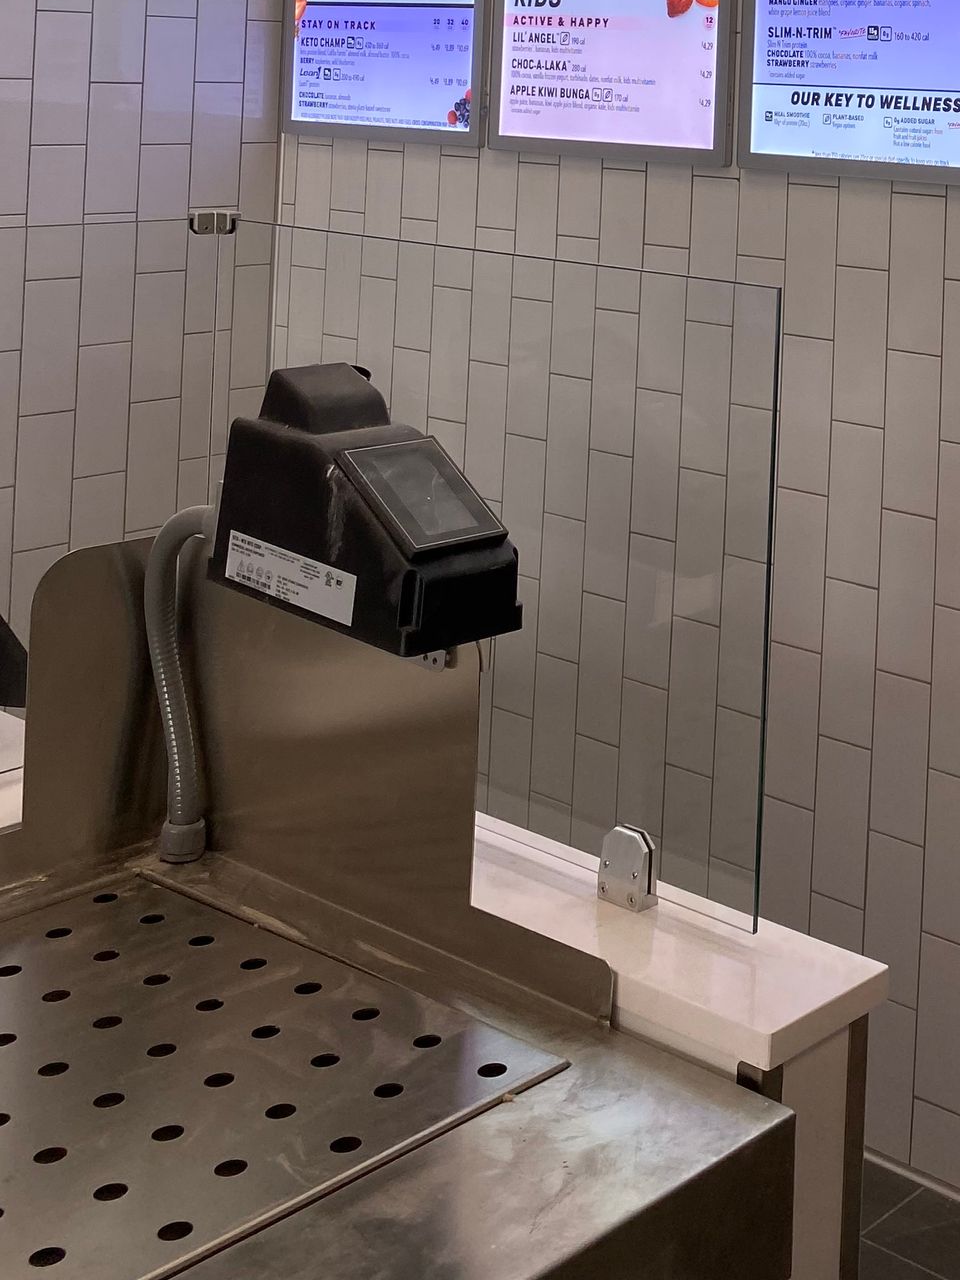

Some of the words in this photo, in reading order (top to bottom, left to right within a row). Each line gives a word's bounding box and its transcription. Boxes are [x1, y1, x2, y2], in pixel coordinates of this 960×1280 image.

[301, 19, 324, 30] STAY
[326, 19, 340, 30] ON
[343, 20, 376, 31] TRACK
[512, 15, 553, 27] ACTIVE
[557, 16, 565, 27] &
[570, 17, 609, 28] HAPPY
[300, 36, 319, 48] KETO
[319, 37, 346, 48] CHAMP
[509, 84, 537, 97] APPLE
[537, 86, 558, 98] KIWI
[559, 87, 591, 100] BUNGA
[790, 90, 821, 107] OUR
[823, 92, 854, 108] KEY
[856, 93, 876, 109] TO
